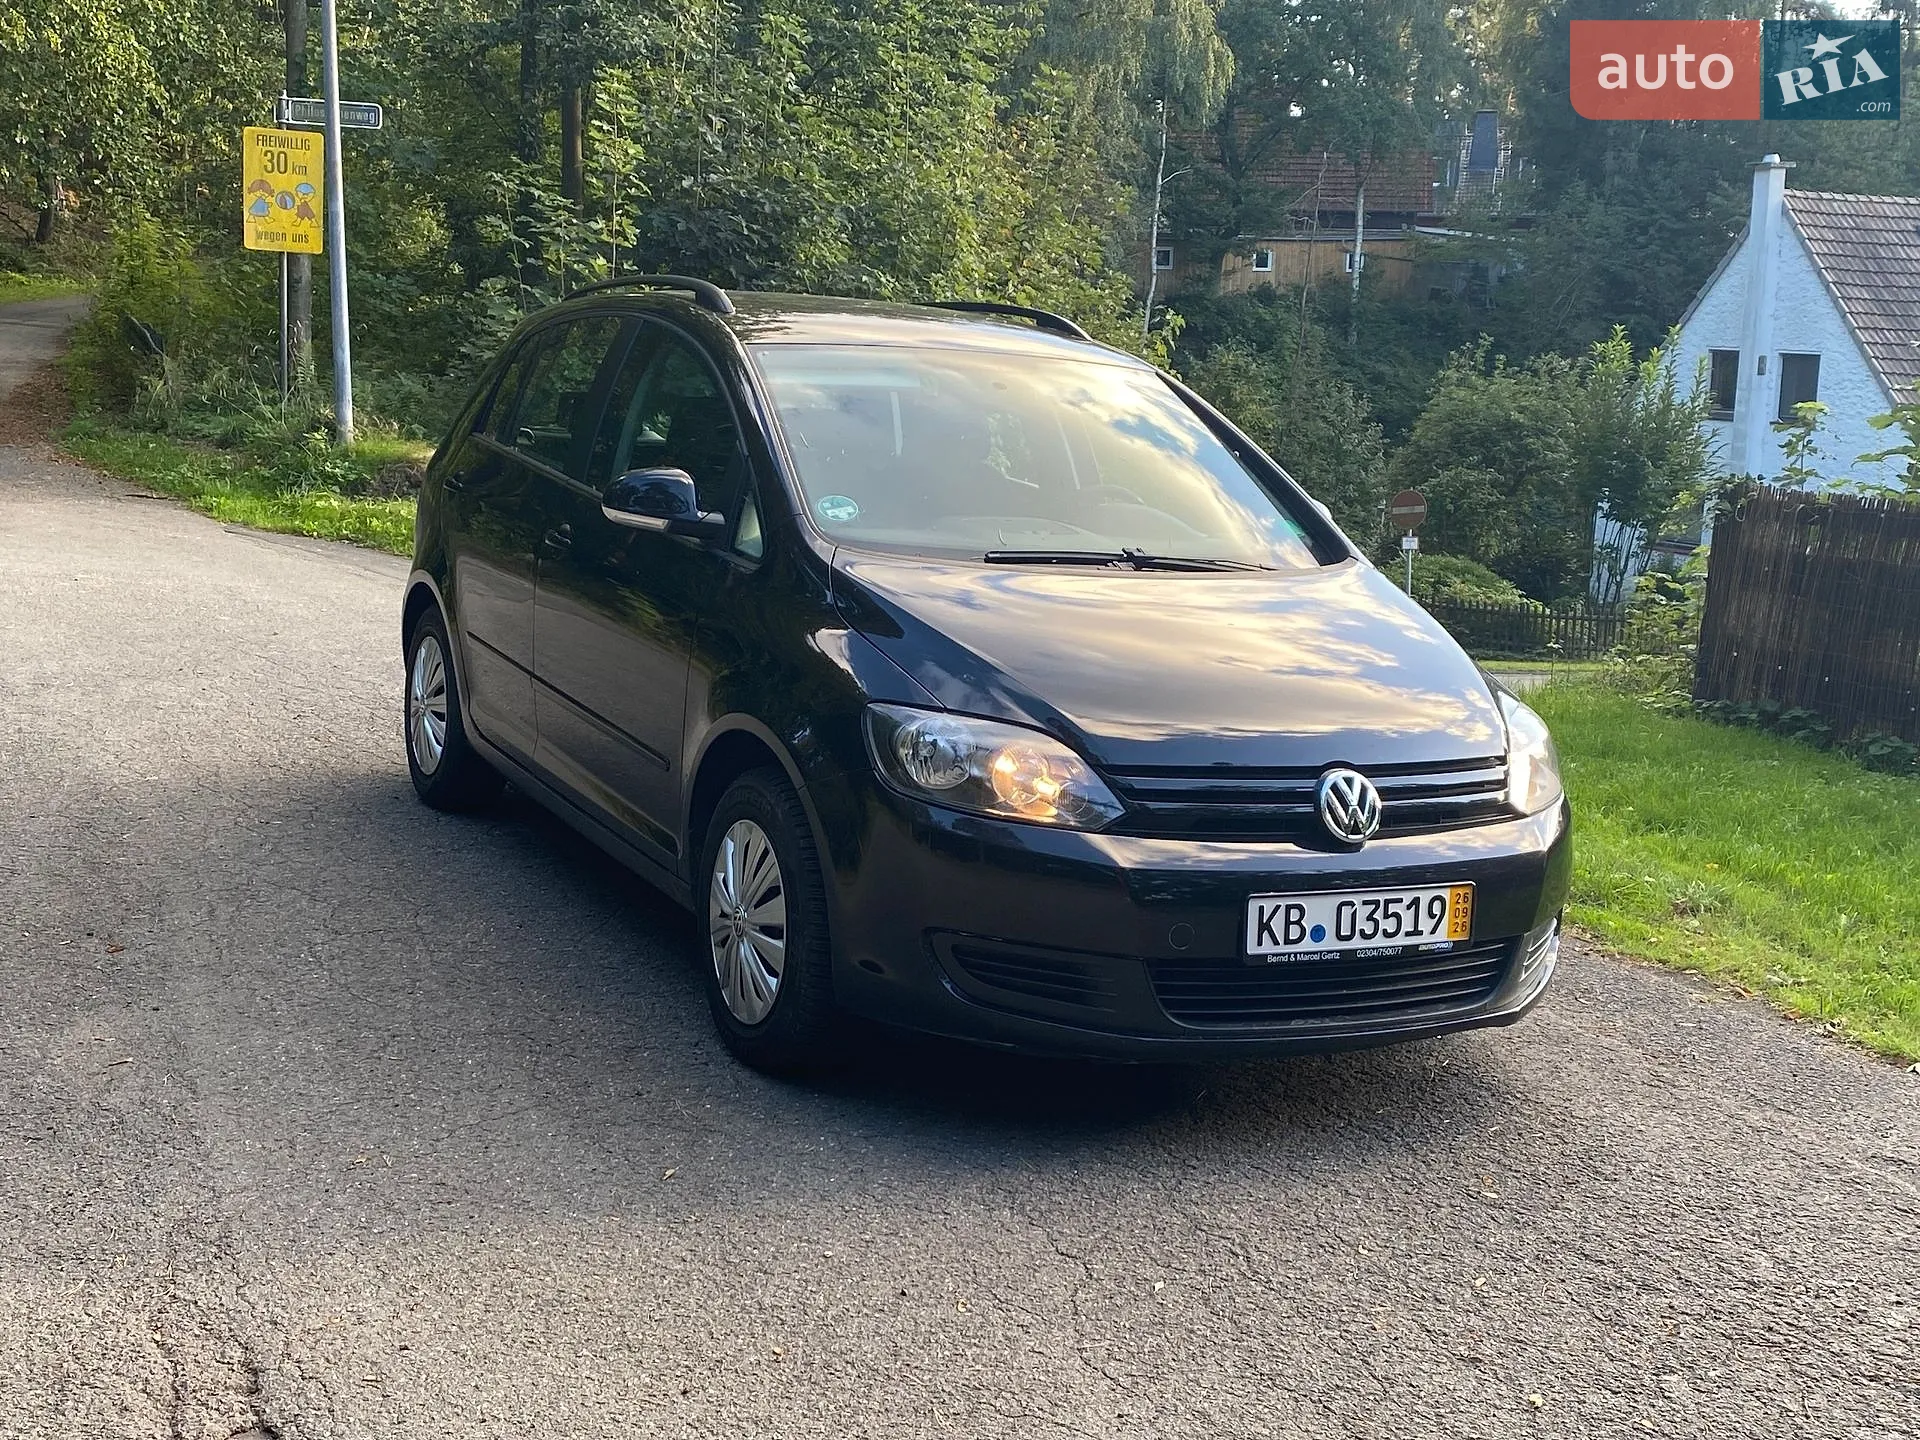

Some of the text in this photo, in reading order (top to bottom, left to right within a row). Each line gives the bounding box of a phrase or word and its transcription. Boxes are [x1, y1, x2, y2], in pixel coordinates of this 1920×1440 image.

[256, 134, 310, 151] FREIWILLIG
[264, 150, 307, 176] 30 km
[256, 229, 309, 243] wegen uns
[1455, 892, 1470, 904] 26
[1454, 907, 1468, 918] 09
[1257, 895, 1447, 947] KB 03519
[1453, 921, 1467, 932] 26
[1267, 953, 1289, 963] Bernd
[1289, 954, 1296, 962] &
[1296, 951, 1320, 961] Marcel
[1321, 951, 1340, 960] Gertz
[1356, 946, 1403, 957] 02304/750077
